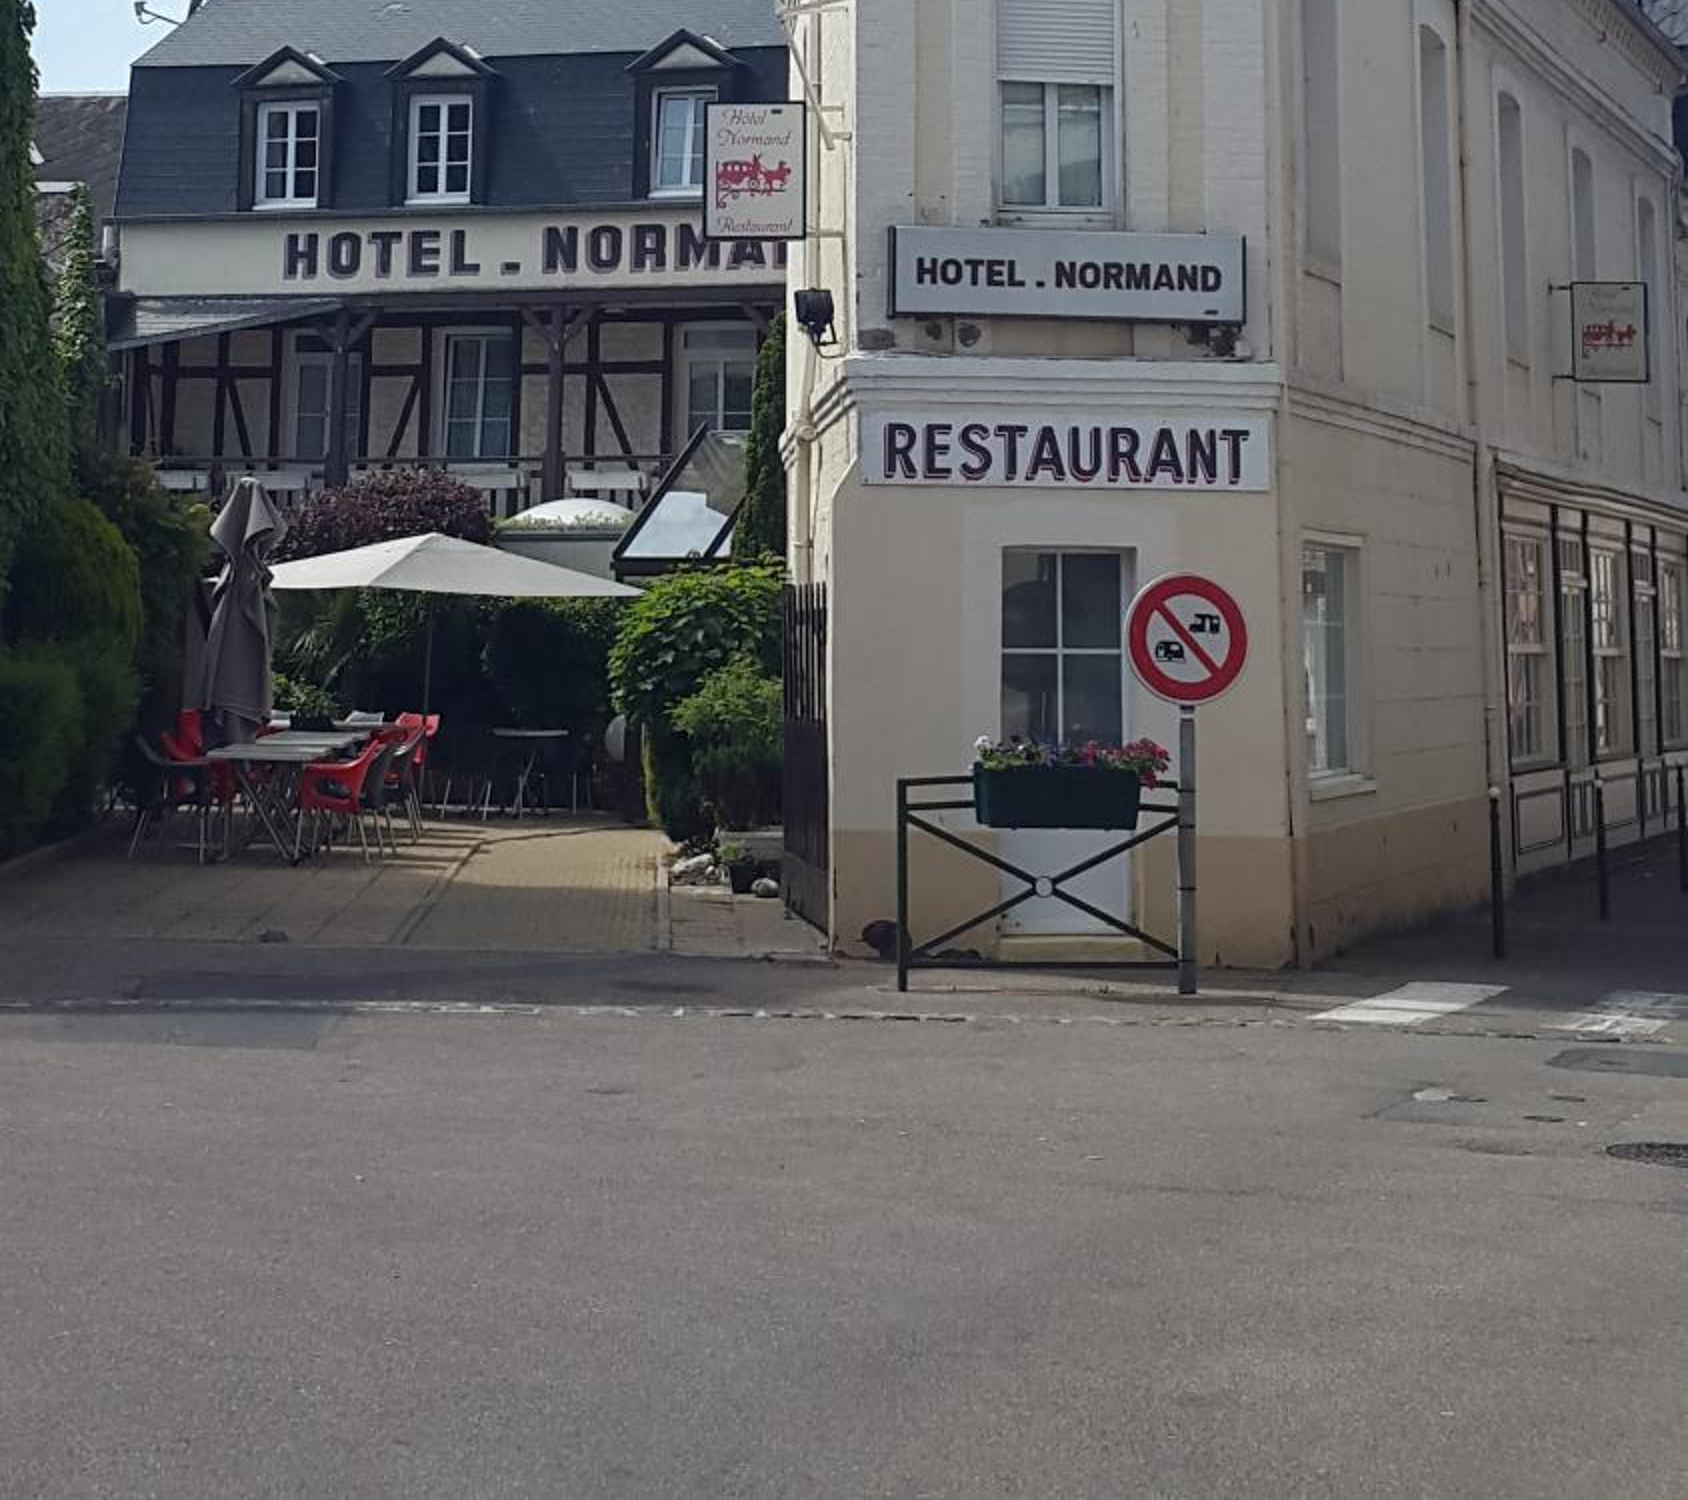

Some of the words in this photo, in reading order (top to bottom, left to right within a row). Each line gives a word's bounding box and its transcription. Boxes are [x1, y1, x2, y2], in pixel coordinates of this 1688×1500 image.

[716, 130, 791, 147] Normand
[716, 217, 793, 233] Restaurant
[284, 229, 480, 280] HOTEL
[541, 223, 787, 273] NORMA
[916, 257, 1026, 288] HOTEL
[1055, 261, 1222, 292] NORMAND
[884, 422, 1250, 485] RESTAURANT
